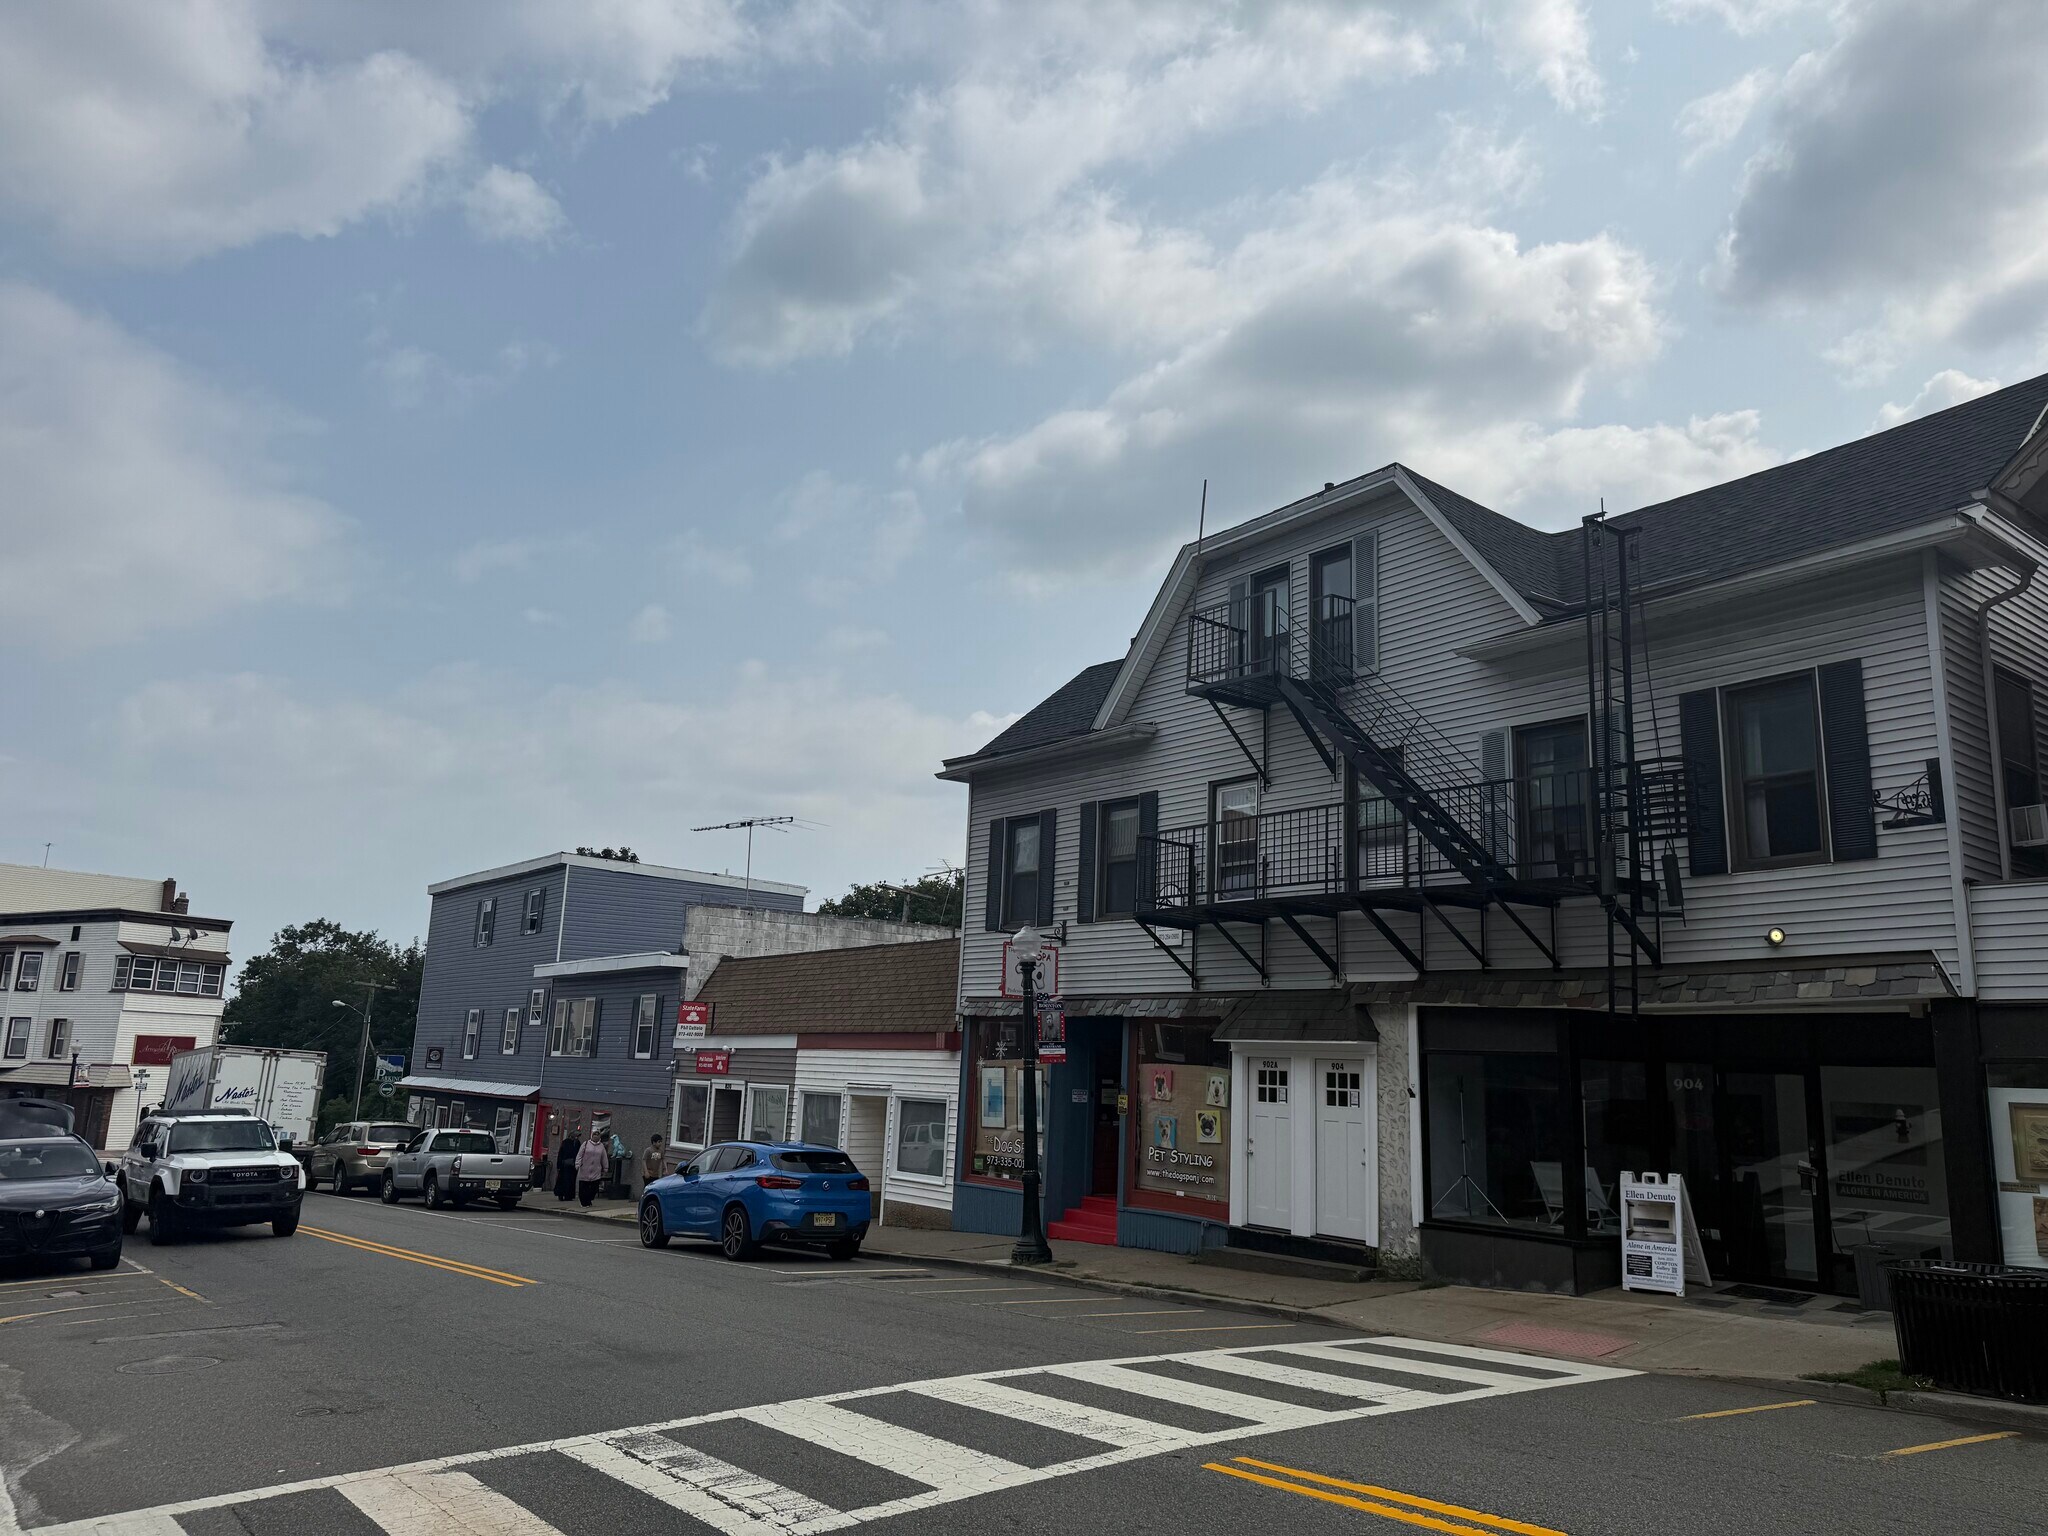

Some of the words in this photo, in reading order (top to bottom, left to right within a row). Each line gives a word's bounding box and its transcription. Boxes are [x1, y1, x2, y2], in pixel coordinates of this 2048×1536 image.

[1331, 1062, 1344, 1070] 904
[375, 1068, 402, 1082] PARKING
[1673, 1079, 1704, 1091] 904
[215, 1087, 257, 1102] Nasto's
[1148, 1146, 1166, 1161] PET
[1170, 1150, 1213, 1167] STYLING
[1147, 1168, 1214, 1184] www.thedogspanj.com
[1838, 1170, 1871, 1184] Ellen
[1876, 1173, 1926, 1188] Denuto
[1625, 1190, 1645, 1199] Ellen
[1646, 1192, 1676, 1201] Denuto
[1840, 1186, 1870, 1196] ALONE
[1871, 1188, 1880, 1196] IN
[1883, 1190, 1926, 1200] AMERICA
[1652, 1244, 1676, 1252] America
